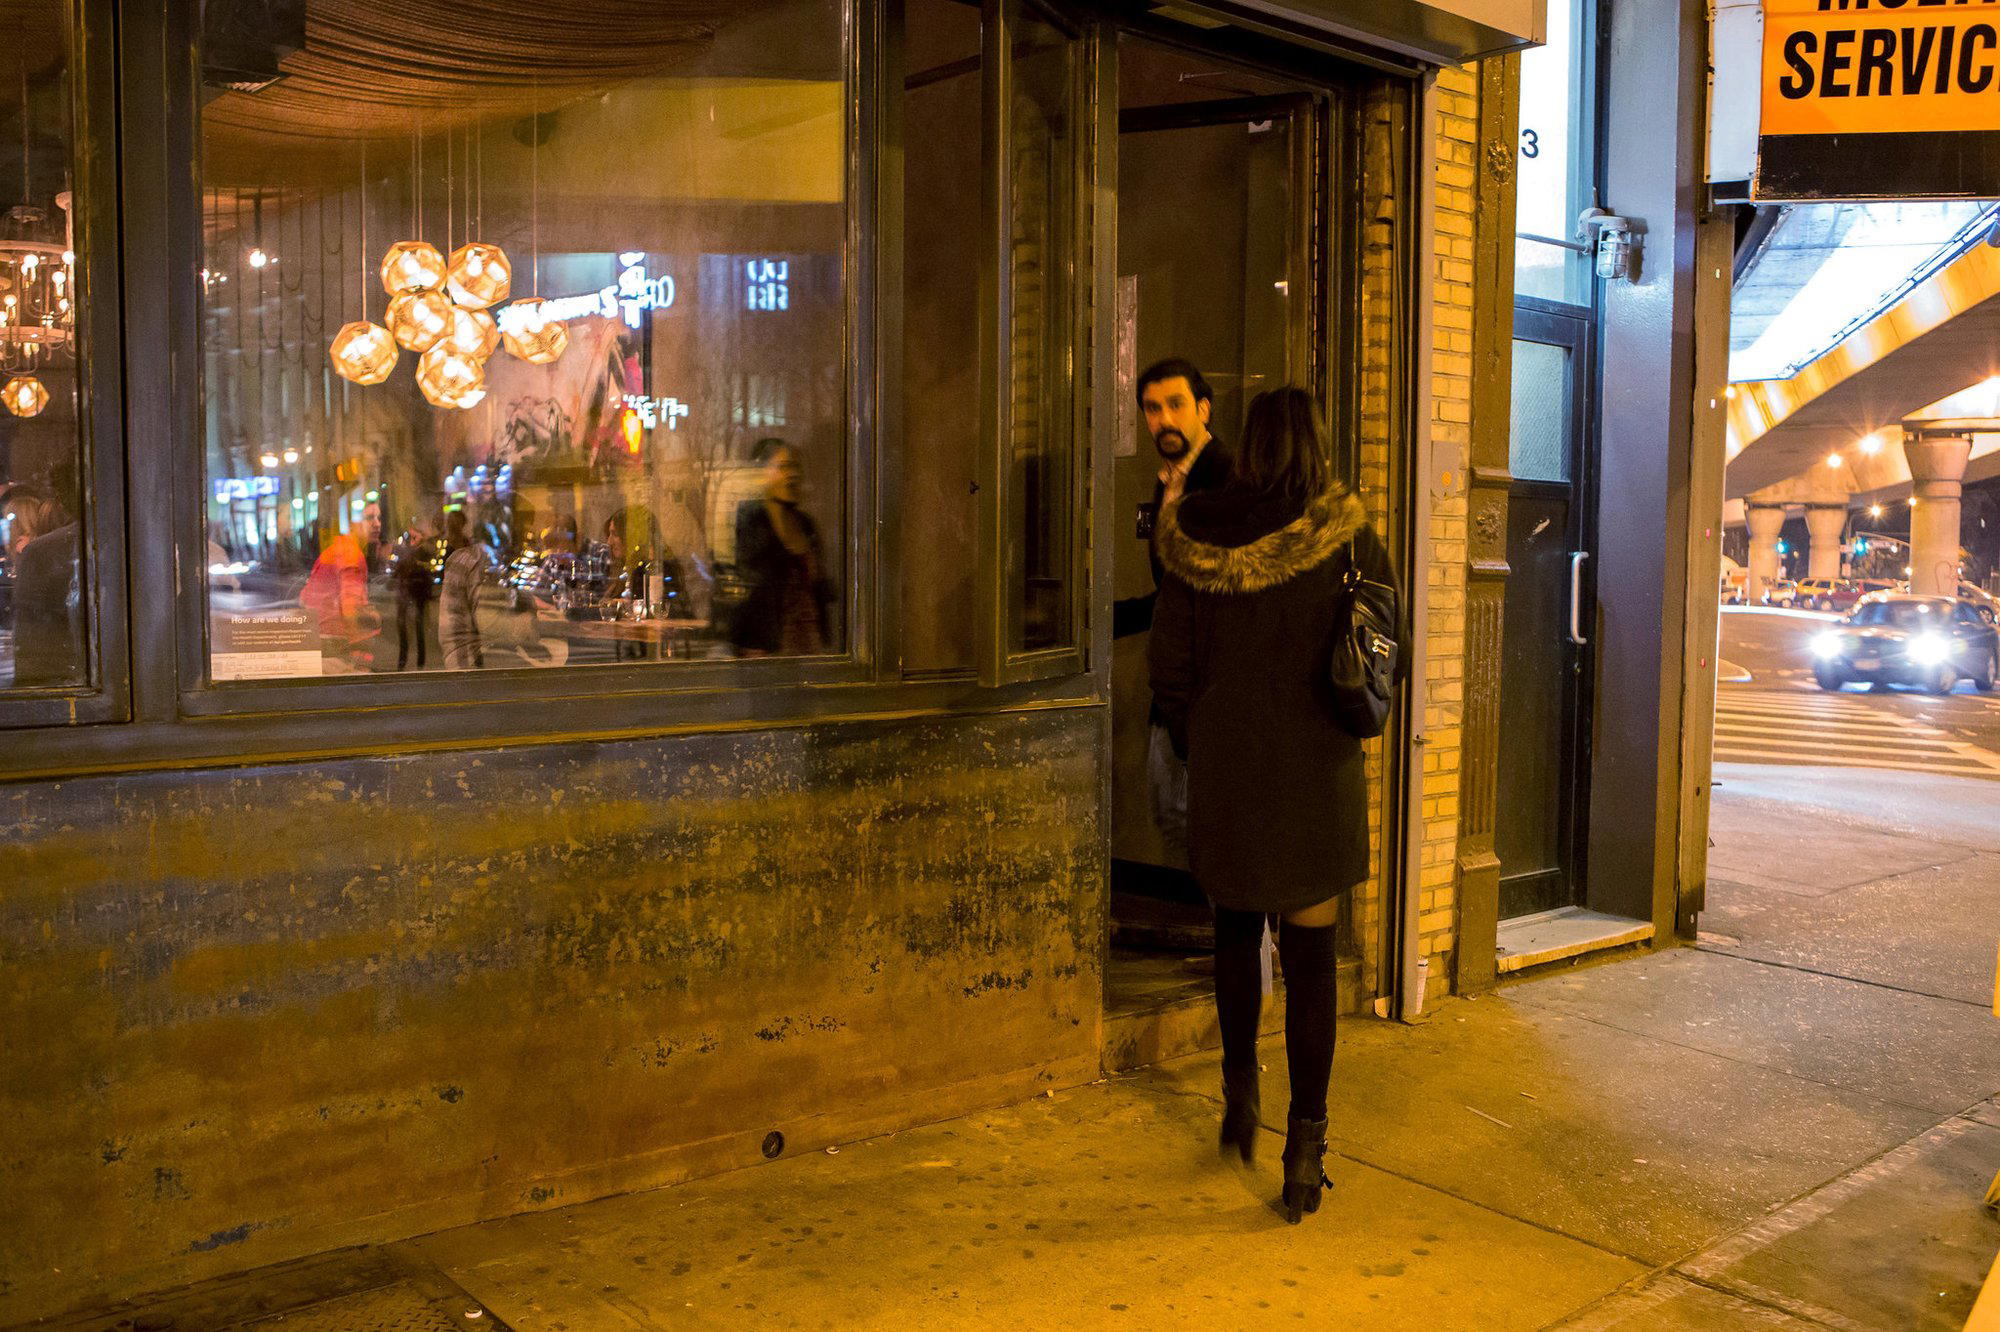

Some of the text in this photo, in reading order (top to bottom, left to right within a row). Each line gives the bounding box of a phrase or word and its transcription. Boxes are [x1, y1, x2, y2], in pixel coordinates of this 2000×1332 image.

[1779, 23, 2000, 99] SERVIC
[1521, 128, 1539, 159] 3
[280, 615, 307, 625] doing?
